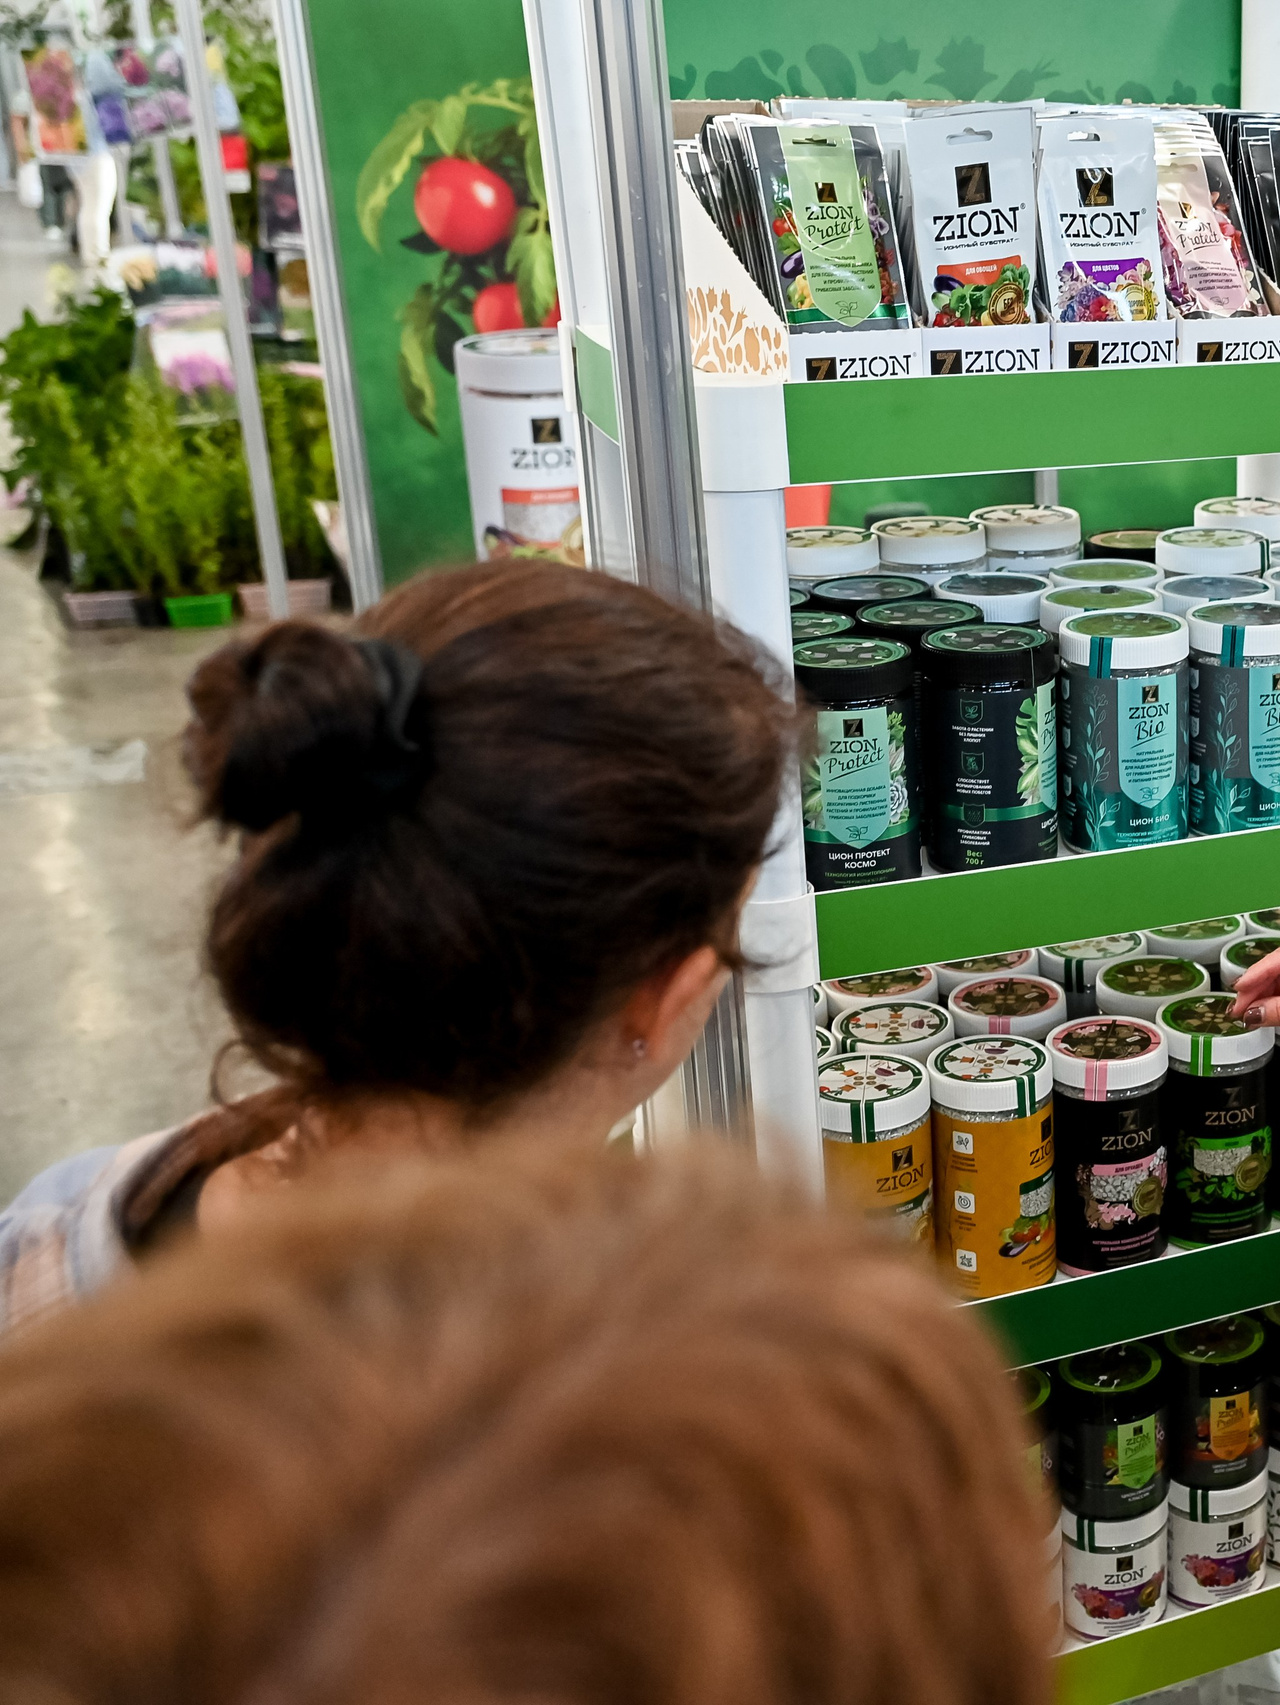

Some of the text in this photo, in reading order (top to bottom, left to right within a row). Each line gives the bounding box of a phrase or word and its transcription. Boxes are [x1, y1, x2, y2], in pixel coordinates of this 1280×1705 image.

[805, 205, 854, 221] ZION
[804, 216, 864, 243] Protect
[933, 206, 1019, 242] ZION
[1059, 211, 1140, 239] ZION
[965, 348, 1040, 373] ZION
[1102, 339, 1173, 364] ZION
[840, 355, 911, 379] ZION
[1129, 703, 1169, 719] ZION
[1134, 720, 1166, 741] Bio
[830, 738, 878, 754] ZION
[824, 747, 885, 774] Protect
[1260, 802, 1280, 811] ЦИОН
[1130, 814, 1169, 826] ЦИОН БИО
[828, 848, 891, 860] ЦИОН ПРОТЕКТ
[966, 849, 982, 857] Вес:
[844, 859, 876, 869] КОСМО
[1205, 1105, 1256, 1126] ZION
[1102, 1128, 1152, 1150] ZION
[876, 1163, 924, 1193] ZION
[1126, 1432, 1149, 1446] ZION
[1216, 1533, 1252, 1553] ZION
[1104, 1567, 1144, 1585] ZION
